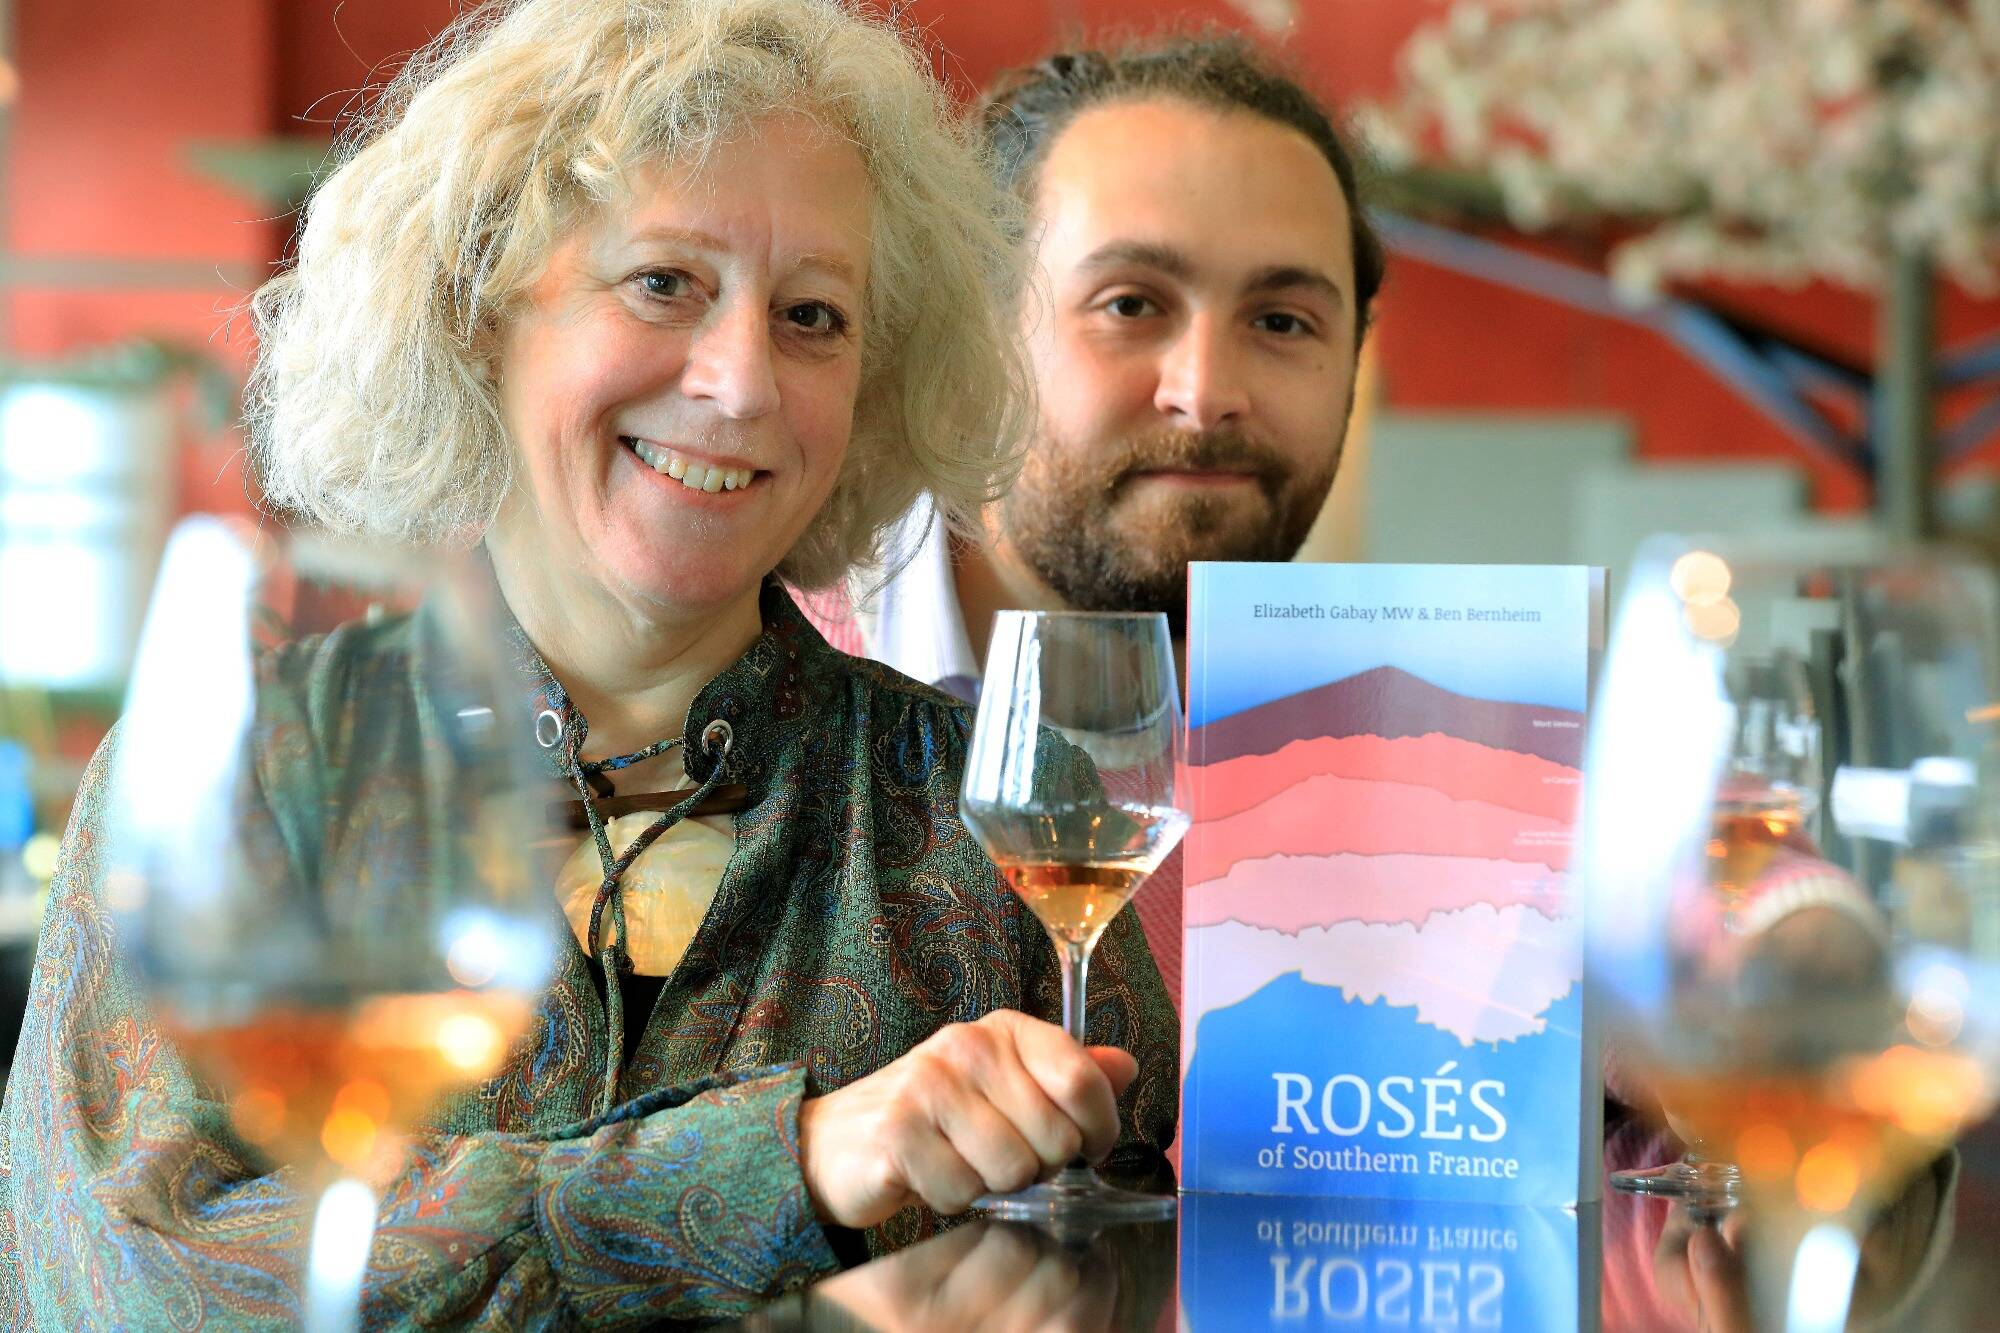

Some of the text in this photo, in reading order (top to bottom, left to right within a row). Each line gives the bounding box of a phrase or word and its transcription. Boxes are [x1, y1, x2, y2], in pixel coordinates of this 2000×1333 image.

[1253, 603, 1541, 623] Elizabeth Gabay MW & Ben Bernheim
[1271, 1061, 1507, 1142] ROSÉS
[1258, 1143, 1519, 1179] of Southern France
